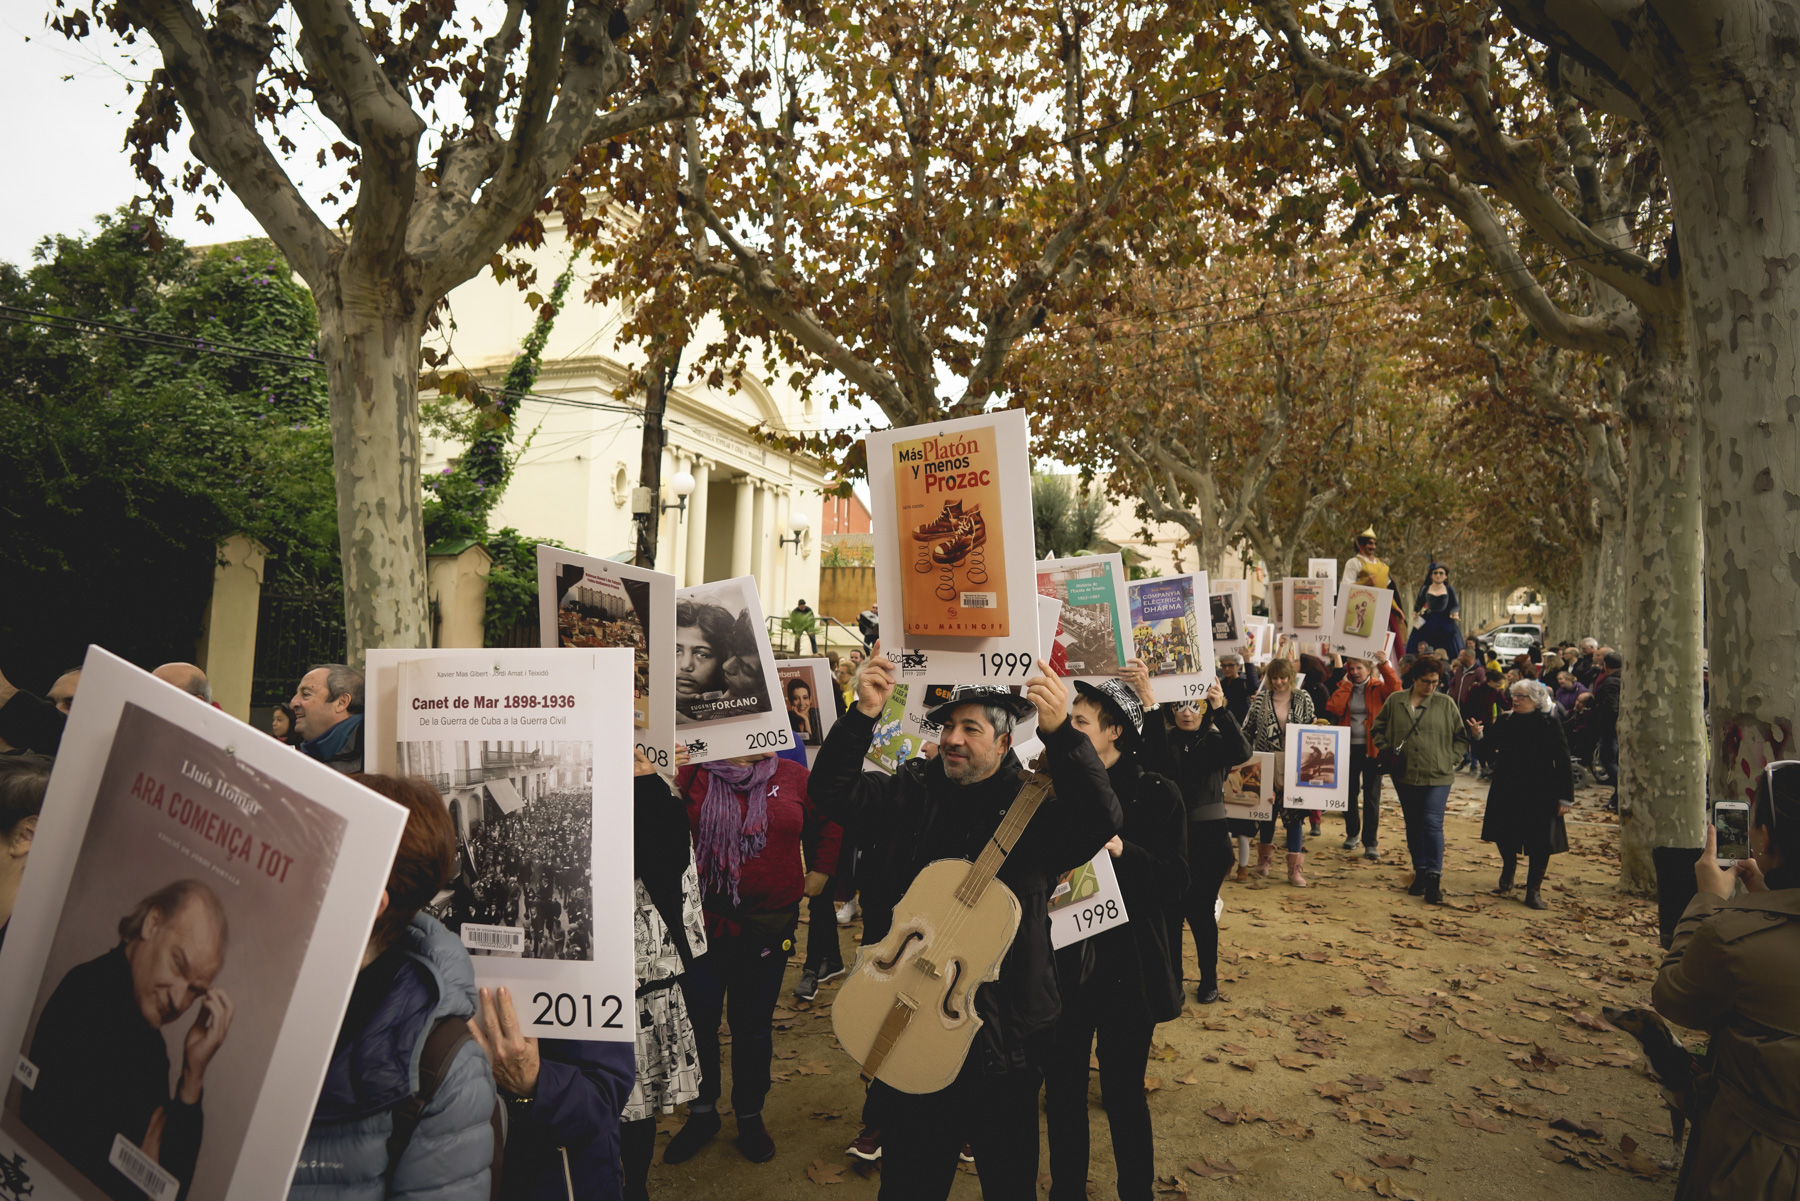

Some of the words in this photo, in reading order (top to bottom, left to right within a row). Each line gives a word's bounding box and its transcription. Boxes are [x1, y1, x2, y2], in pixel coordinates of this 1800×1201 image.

[899, 448, 923, 463] Más
[922, 435, 980, 462] Platón
[911, 465, 920, 479] y
[924, 456, 970, 475] menos
[925, 468, 991, 494] Prozac
[1142, 590, 1181, 600] COMPANYIA
[1144, 603, 1182, 614] DHARMA
[1363, 651, 1376, 659] 197
[979, 652, 1033, 677] 1999
[528, 669, 549, 677] Teixidó
[778, 669, 801, 679] ntserrat
[412, 696, 449, 710] Canet
[453, 696, 470, 709] de
[473, 696, 499, 708] Mar
[503, 695, 576, 708] 1898-1936
[690, 703, 712, 711] EUGENI
[711, 696, 758, 711] FORCANO
[419, 717, 430, 726] De
[432, 717, 439, 725] la
[440, 717, 467, 726] Guerra
[469, 717, 479, 725] de
[481, 716, 501, 725] Cuba
[510, 716, 518, 725] la
[520, 716, 548, 725] Guerra
[549, 716, 567, 725] Civil
[745, 729, 788, 750] 2005
[181, 760, 213, 789] Lluís
[214, 778, 262, 816] Homar
[1325, 799, 1346, 809] 1984
[1248, 811, 1270, 819] 1985
[130, 772, 166, 811] ARA
[167, 792, 253, 863] COMENÇA
[257, 841, 294, 883] TOT
[1072, 899, 1119, 932] 1998
[532, 991, 624, 1029] 2012
